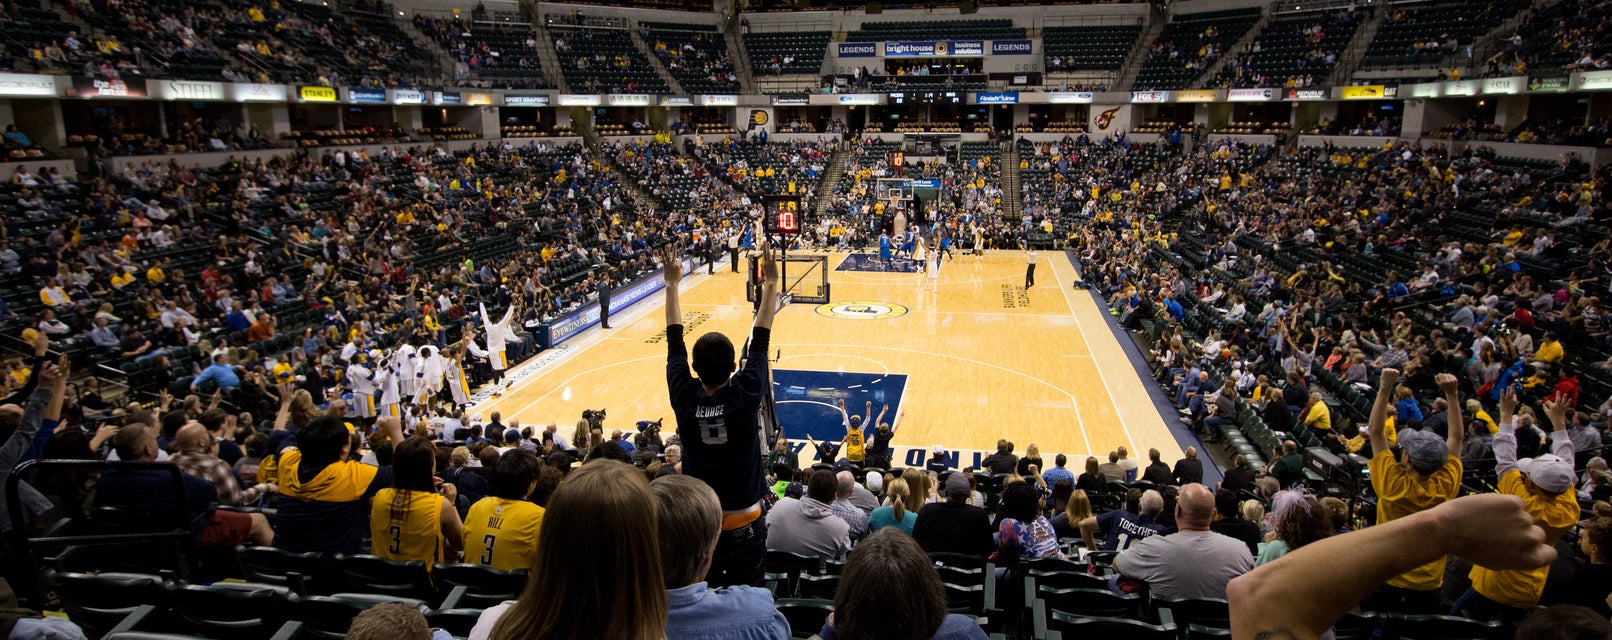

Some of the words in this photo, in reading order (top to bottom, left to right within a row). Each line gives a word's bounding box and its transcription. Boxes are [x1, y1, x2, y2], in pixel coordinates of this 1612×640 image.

[887, 44, 909, 53] bright
[994, 43, 1031, 51] LEGENDS
[93, 79, 110, 88] the
[1495, 80, 1511, 89] STAR
[1384, 87, 1397, 95] CAT
[780, 212, 794, 230] 10
[553, 315, 587, 340] EYEWITNESS
[695, 404, 725, 418] GEORGE
[488, 516, 503, 530] HILL
[388, 525, 400, 555] 3
[480, 534, 497, 566] 3
